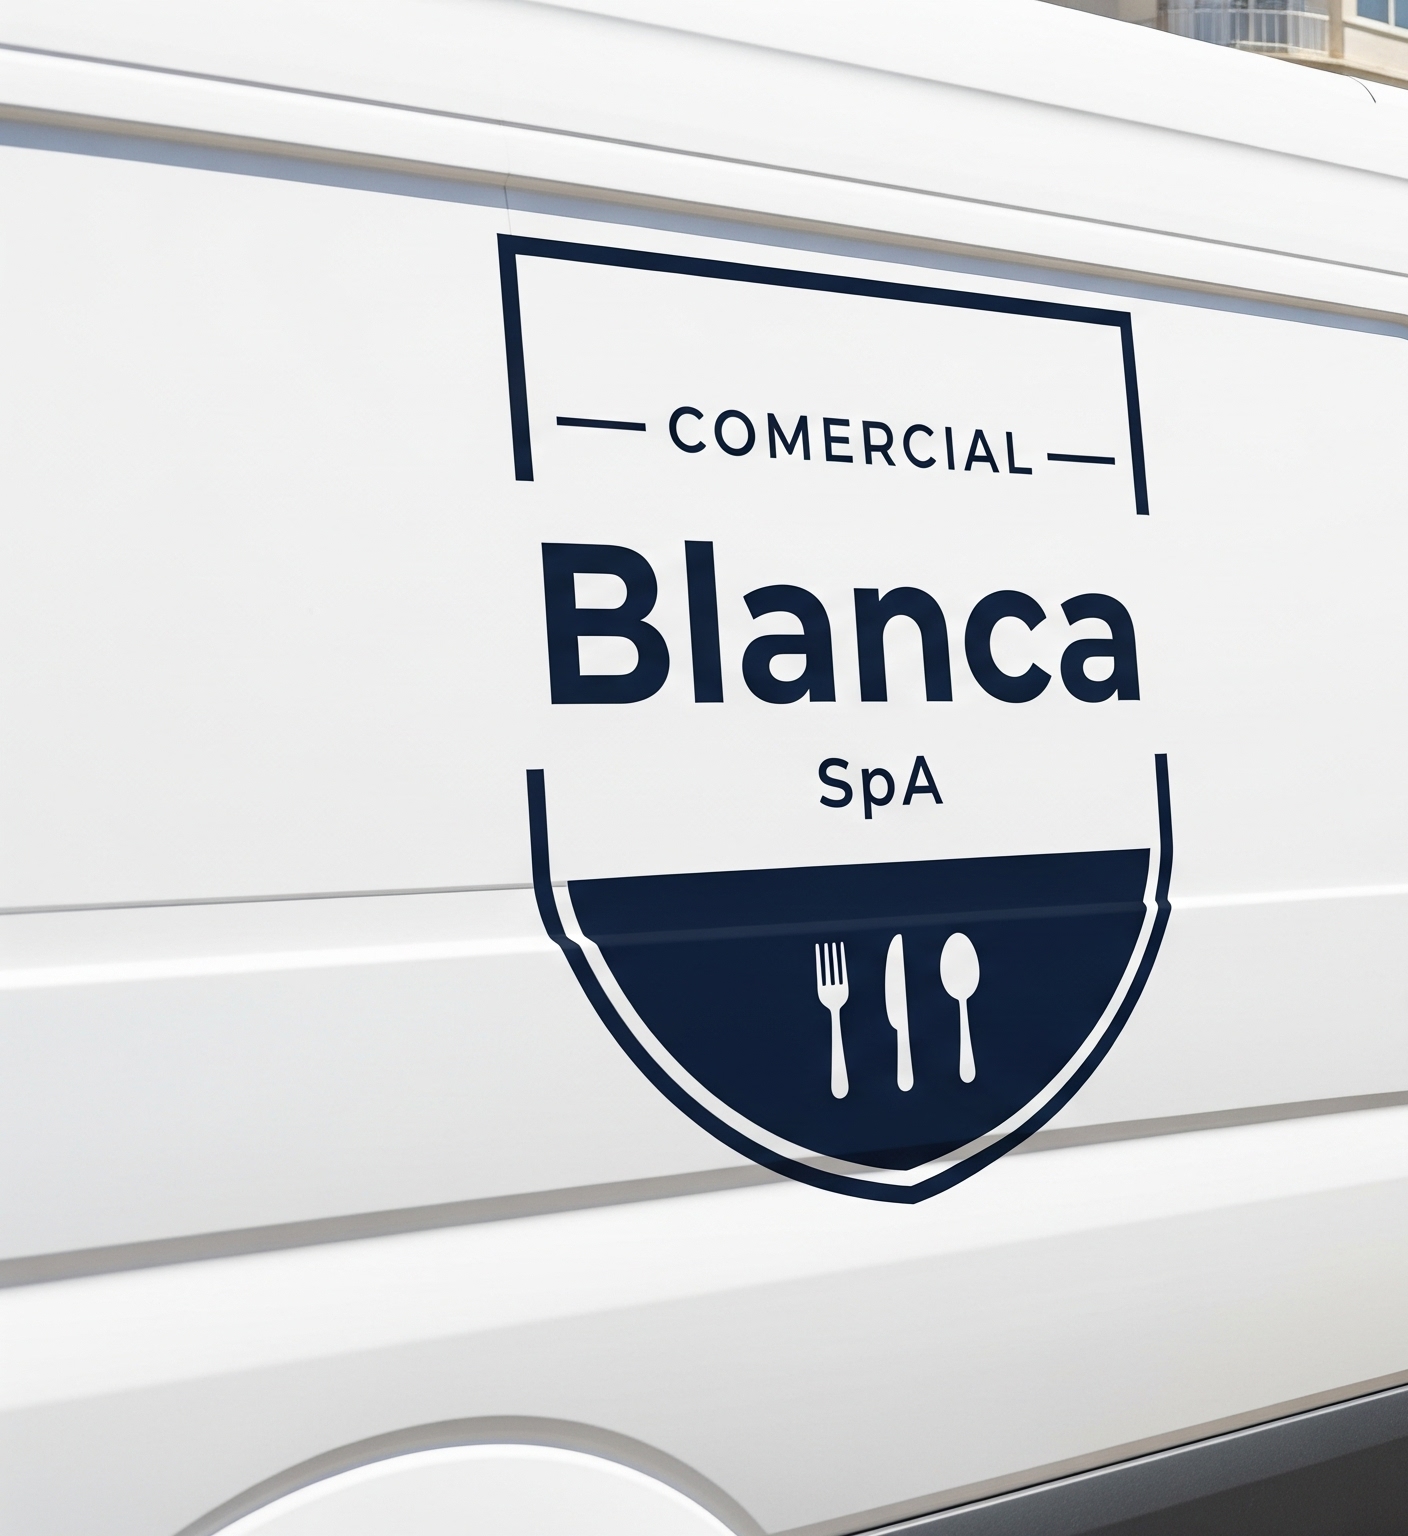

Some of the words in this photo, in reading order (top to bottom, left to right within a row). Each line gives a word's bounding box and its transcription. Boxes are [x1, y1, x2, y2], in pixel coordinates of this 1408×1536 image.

[669, 406, 1032, 475] COMERCIAL
[541, 540, 1140, 704] Blanca
[818, 755, 943, 819] SpA
